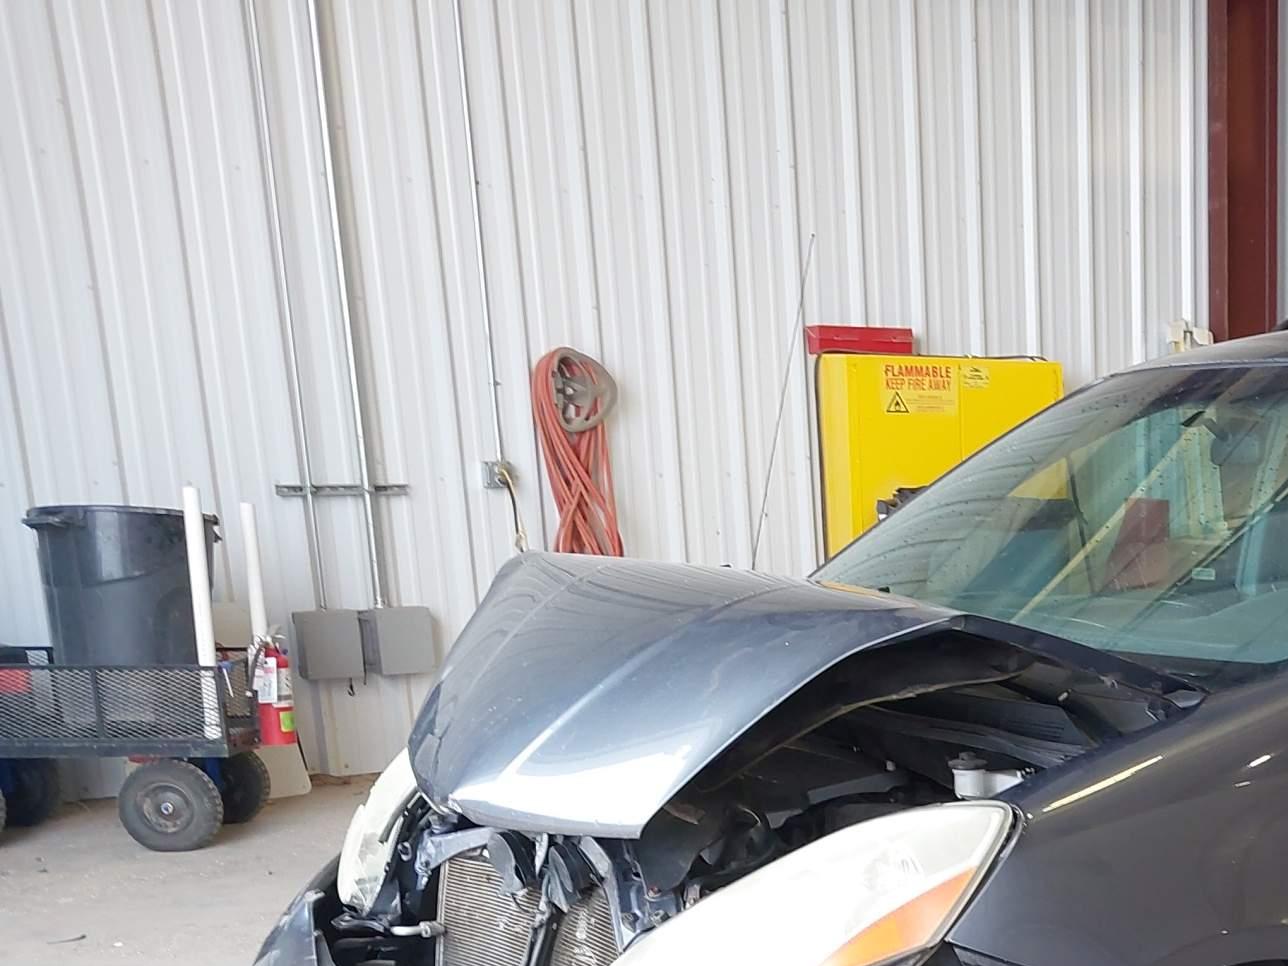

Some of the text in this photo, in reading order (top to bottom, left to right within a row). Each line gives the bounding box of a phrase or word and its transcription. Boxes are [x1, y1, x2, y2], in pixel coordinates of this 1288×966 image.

[884, 364, 952, 379] FLAMMABLE
[886, 378, 951, 392] KEEP FIRE AWAY
